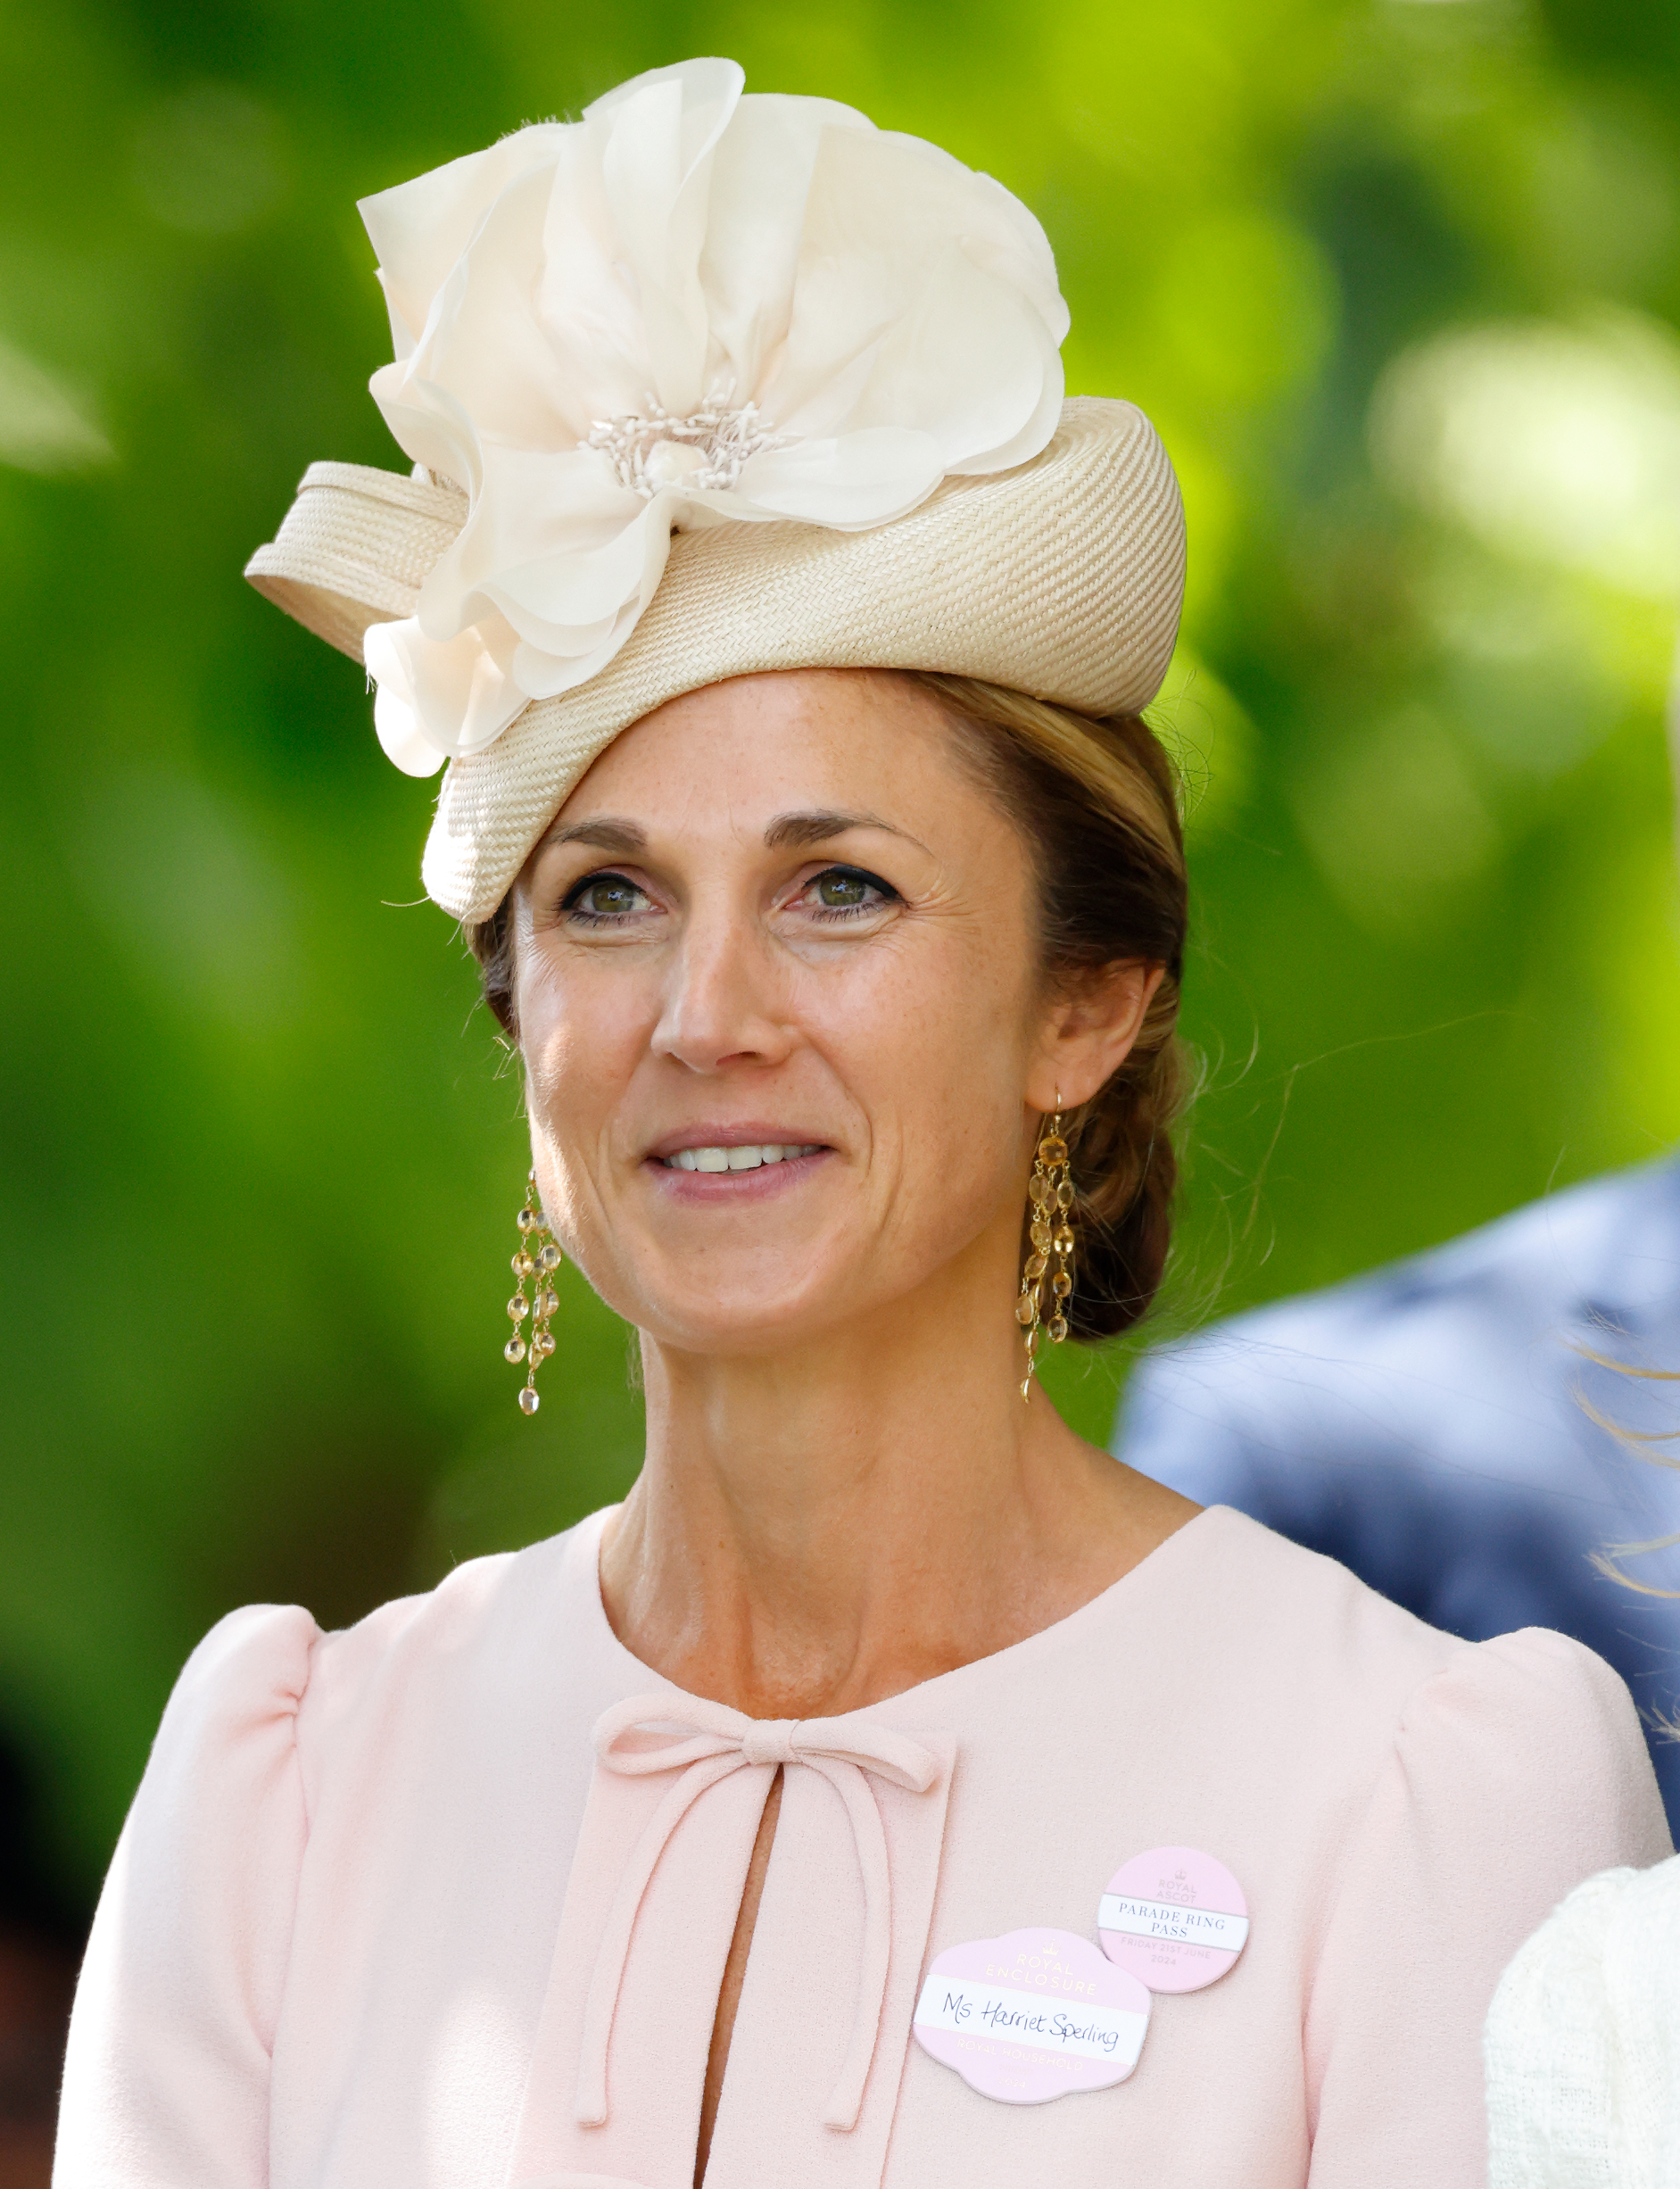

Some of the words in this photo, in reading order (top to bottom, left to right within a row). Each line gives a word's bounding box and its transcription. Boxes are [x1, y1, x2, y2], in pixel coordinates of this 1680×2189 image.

[1156, 1891, 1196, 1903] ASCOT
[1158, 1878, 1197, 1894] ROYAL
[1119, 1903, 1181, 1923] PARADE
[1186, 1914, 1226, 1930] RING
[1151, 1922, 1188, 1938] PASS
[1121, 1936, 1157, 1951] FRIDAY
[1160, 1944, 1181, 1954] 21ST
[1184, 1948, 1211, 1960] JUNE
[1016, 1953, 1073, 1976] ROYAL
[1151, 1954, 1177, 1966] 2024
[985, 1964, 1097, 1996] ENCLOSURE
[943, 1993, 972, 2024] Ms
[981, 2001, 1047, 2032] Harriet
[1049, 2013, 1119, 2052] Sperling
[956, 2038, 997, 2055] ROYAL
[1002, 2047, 1083, 2071] HOUSEHOLD
